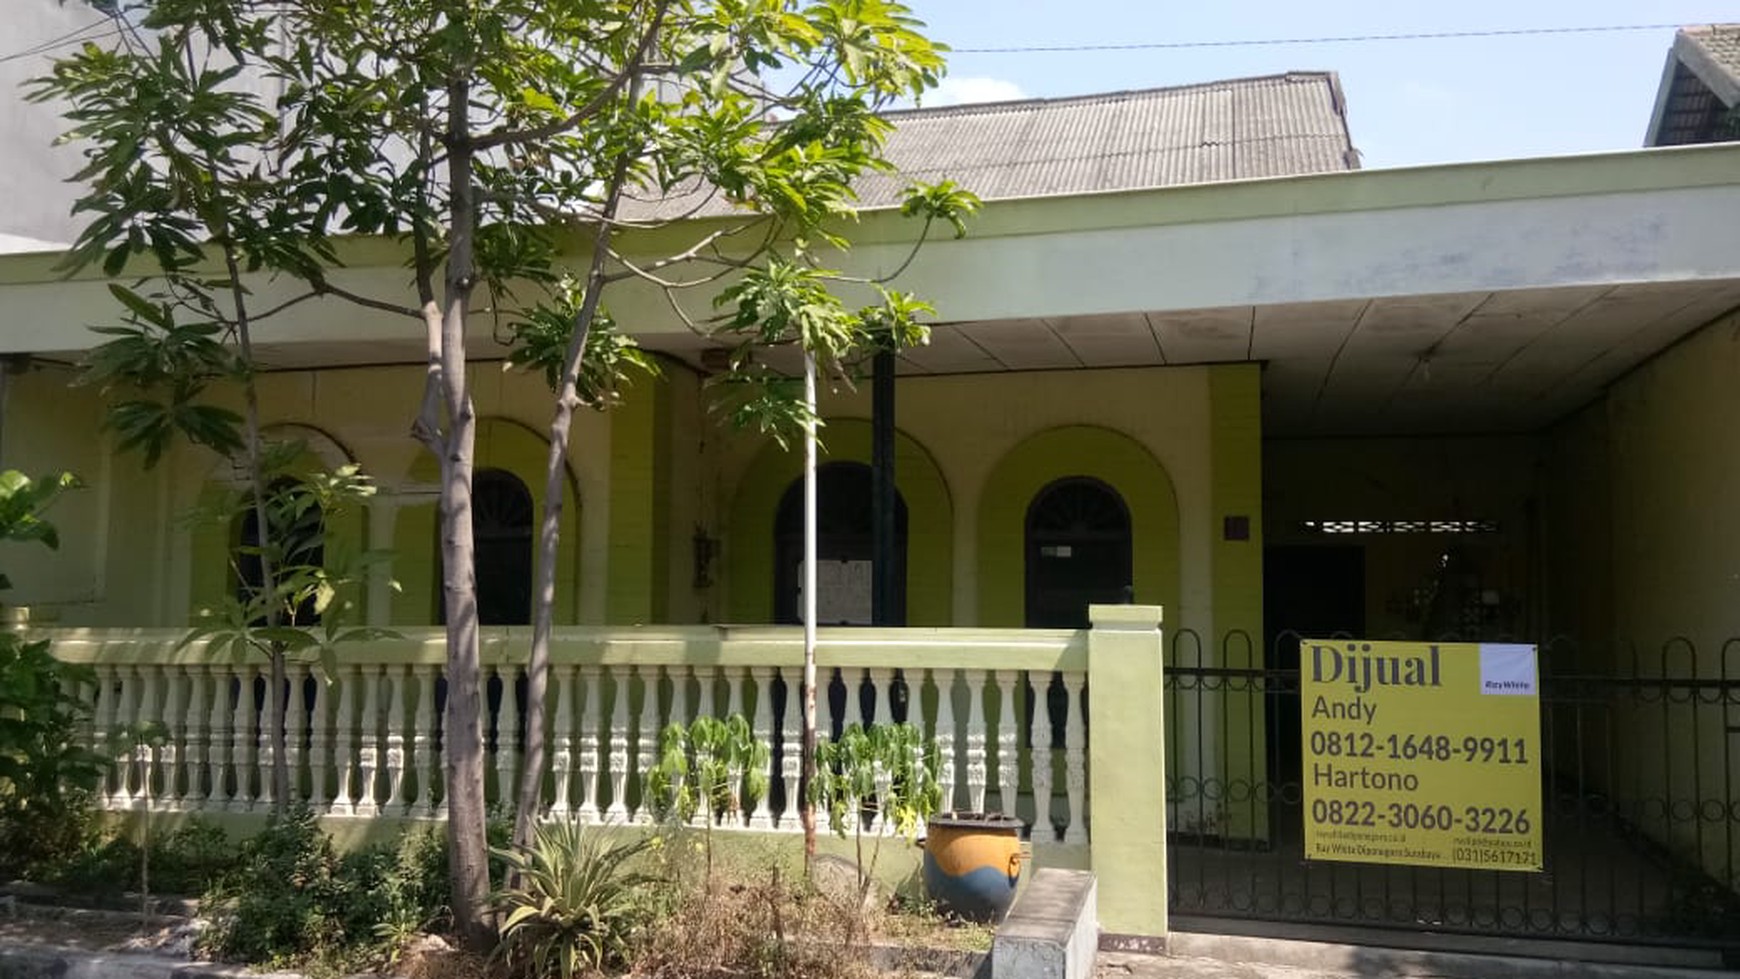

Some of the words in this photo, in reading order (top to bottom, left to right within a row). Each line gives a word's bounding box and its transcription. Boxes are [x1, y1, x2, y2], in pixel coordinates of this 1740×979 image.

[1311, 643, 1443, 693] Dijual
[1311, 694, 1377, 725] Andy
[1310, 730, 1529, 764] 0812-1648-9911
[1313, 763, 1419, 791] Hartono
[1312, 798, 1530, 835] 0822-3060-3226
